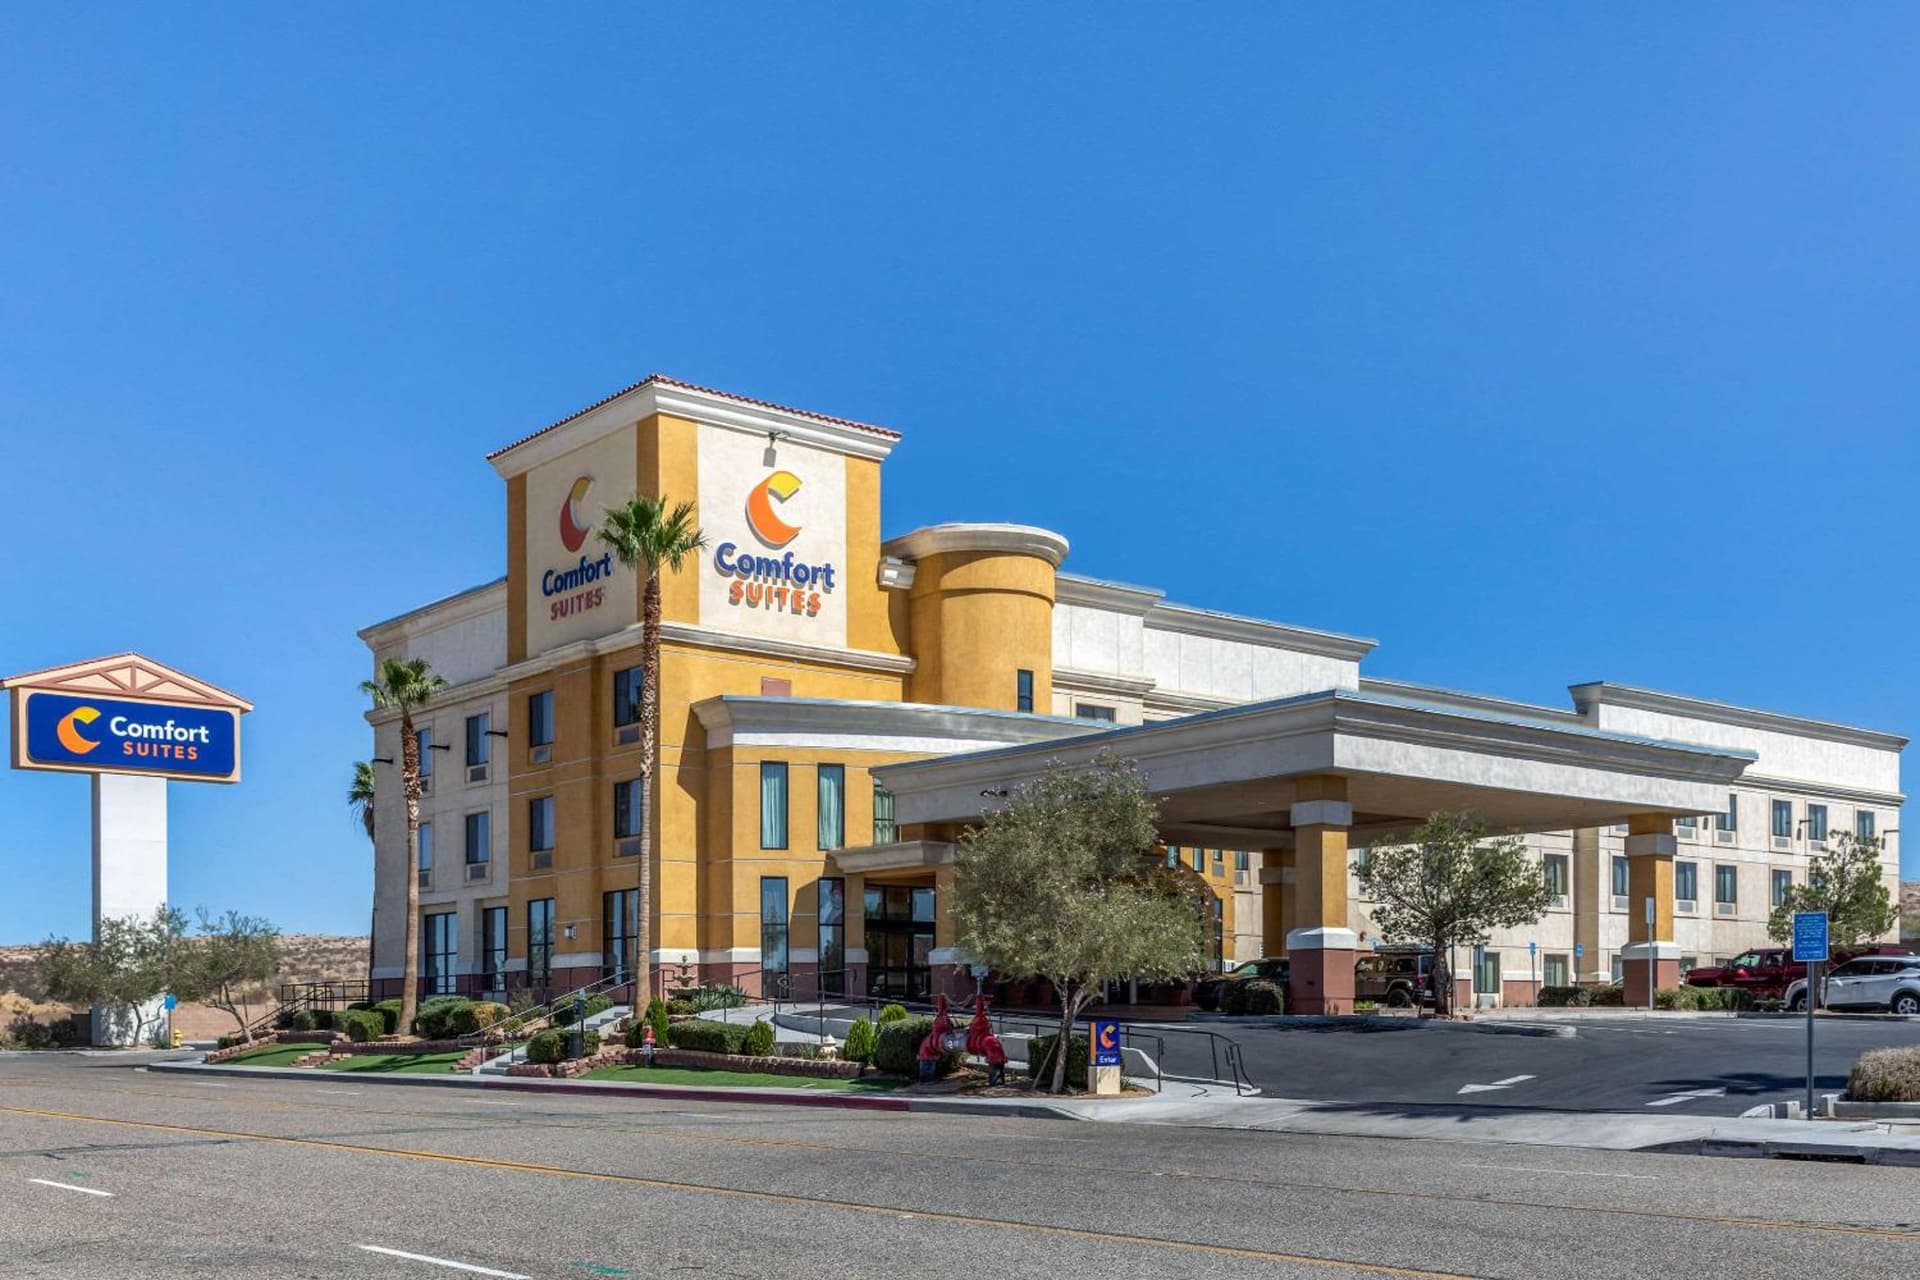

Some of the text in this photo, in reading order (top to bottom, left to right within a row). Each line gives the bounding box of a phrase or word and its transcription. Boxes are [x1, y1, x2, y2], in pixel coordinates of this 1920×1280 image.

[543, 553, 612, 596] Comfort
[716, 543, 835, 588] Comfort
[551, 588, 603, 620] SUITES
[730, 581, 821, 613] SUITES
[110, 716, 209, 743] Comfort
[123, 742, 198, 759] SUITES
